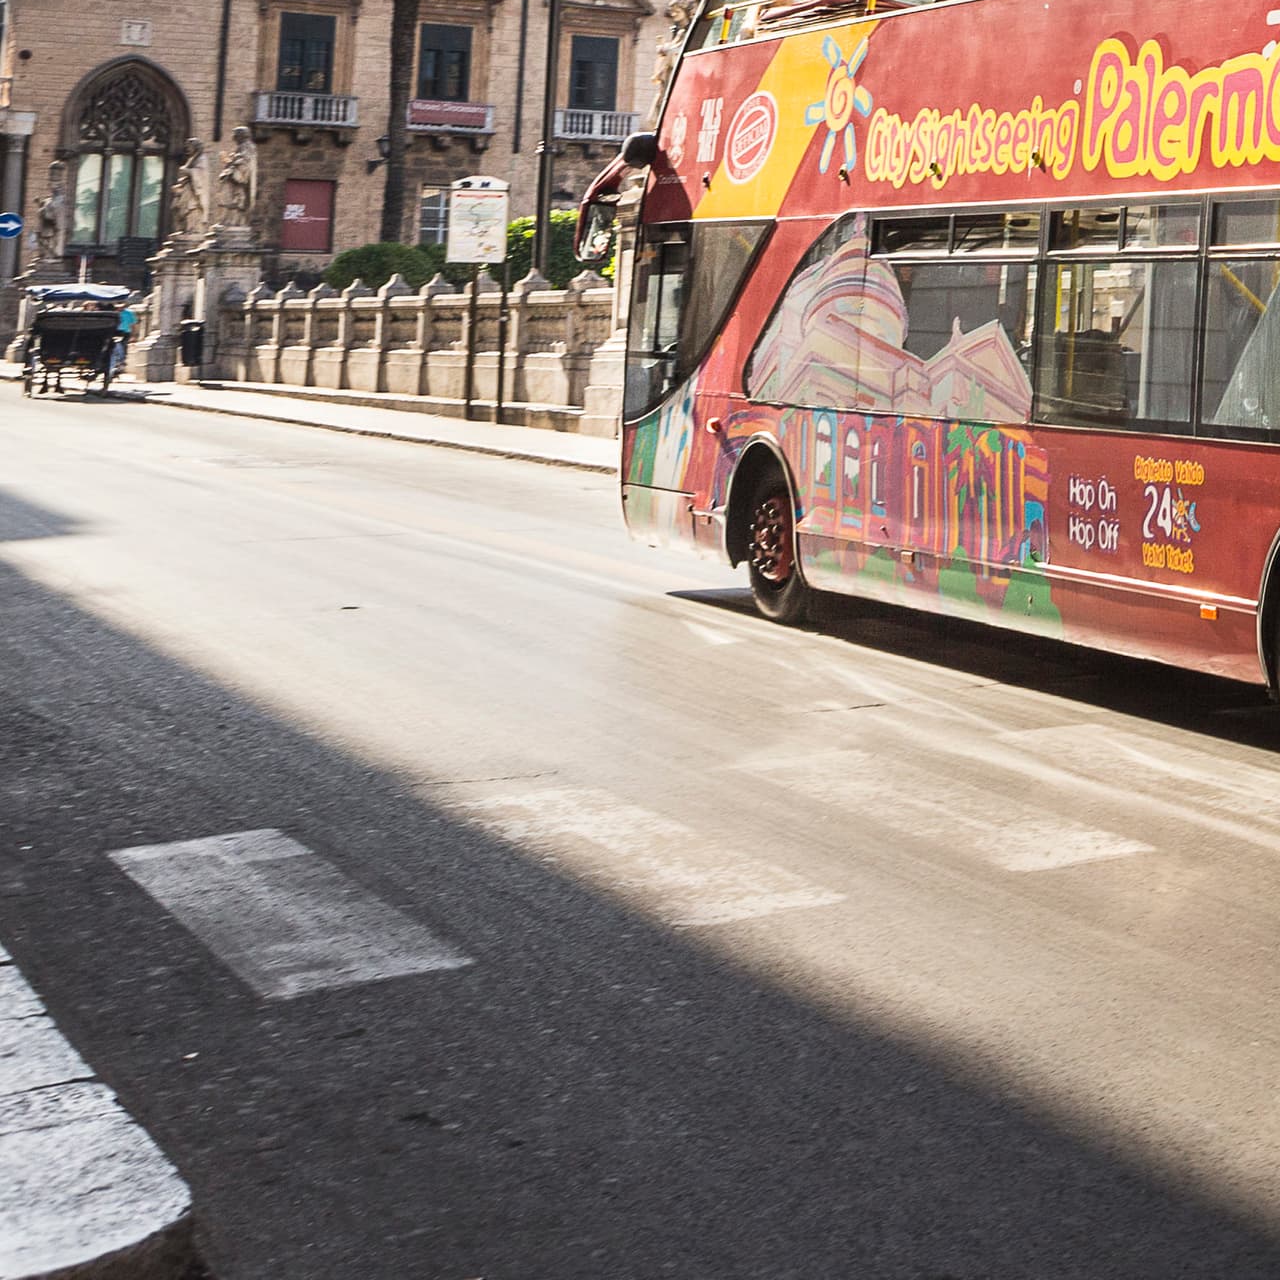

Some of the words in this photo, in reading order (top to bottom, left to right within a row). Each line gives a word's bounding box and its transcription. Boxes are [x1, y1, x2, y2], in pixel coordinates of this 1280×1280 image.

[1069, 477, 1095, 511] Hop
[1098, 480, 1117, 511] On
[1143, 485, 1172, 538] 24
[1069, 516, 1095, 550] Hop
[1098, 519, 1119, 551] Off
